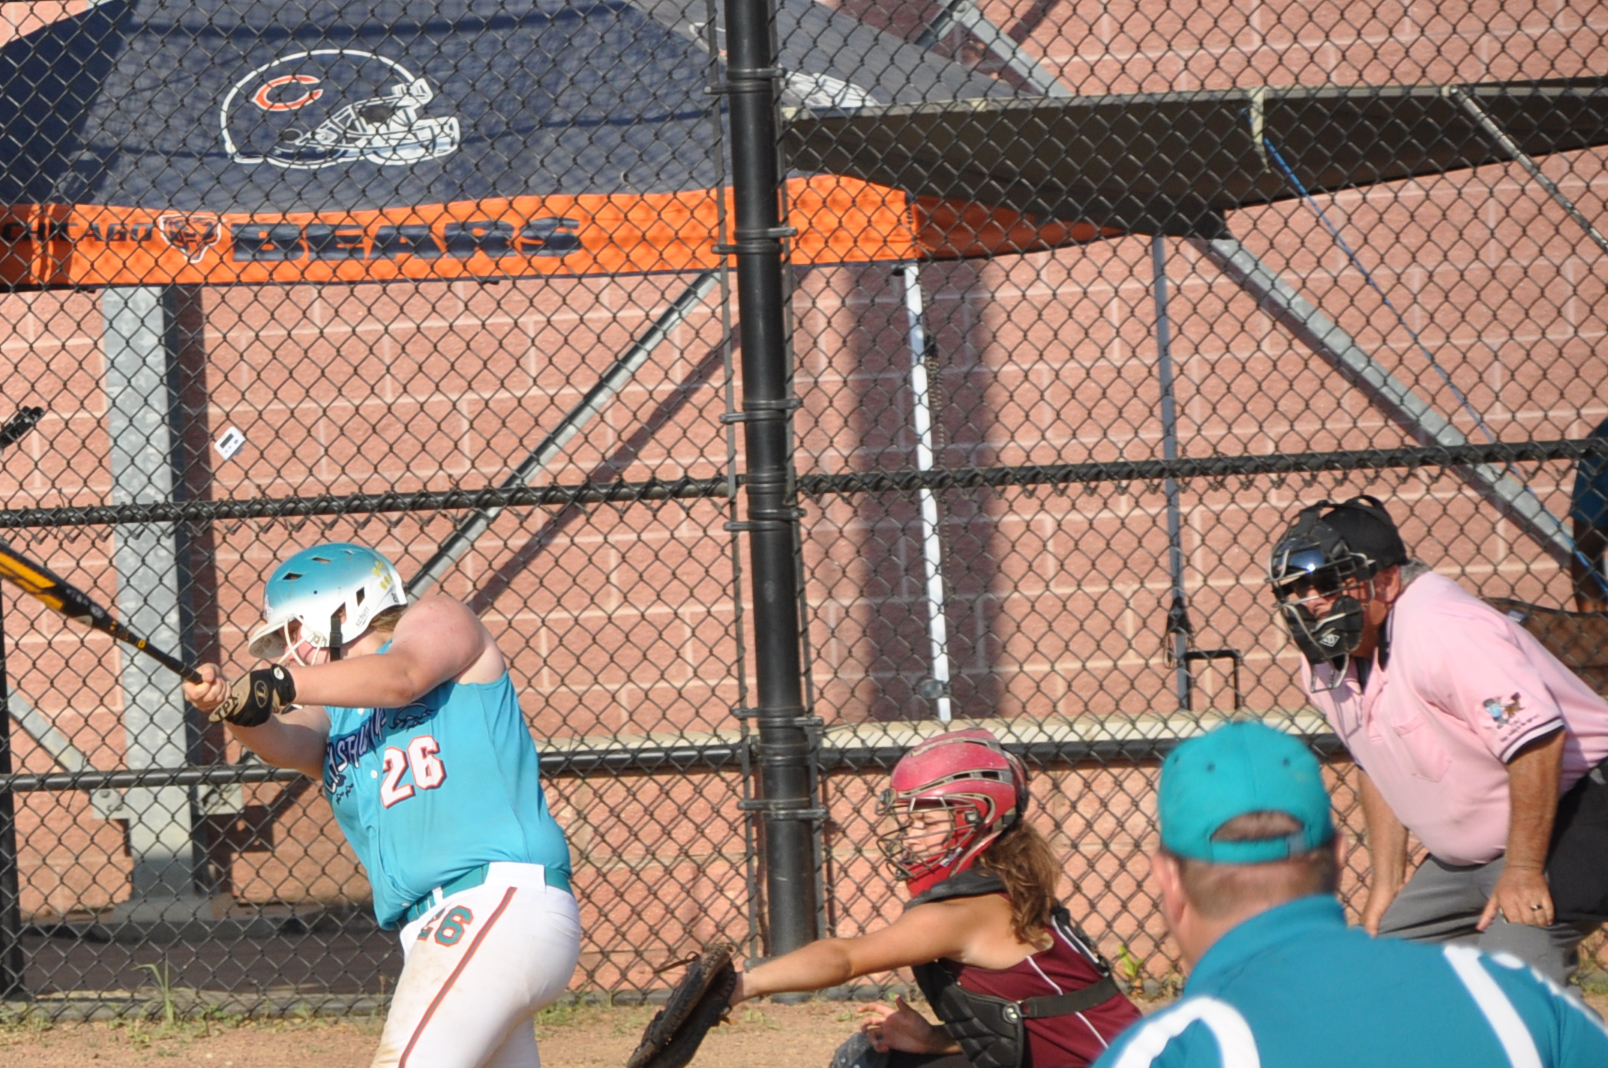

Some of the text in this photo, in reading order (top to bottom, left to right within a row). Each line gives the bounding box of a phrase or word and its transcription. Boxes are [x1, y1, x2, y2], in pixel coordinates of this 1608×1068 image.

[2, 217, 581, 262] CHICAGO BEARS
[215, 694, 239, 719] TPX
[380, 734, 447, 809] 26
